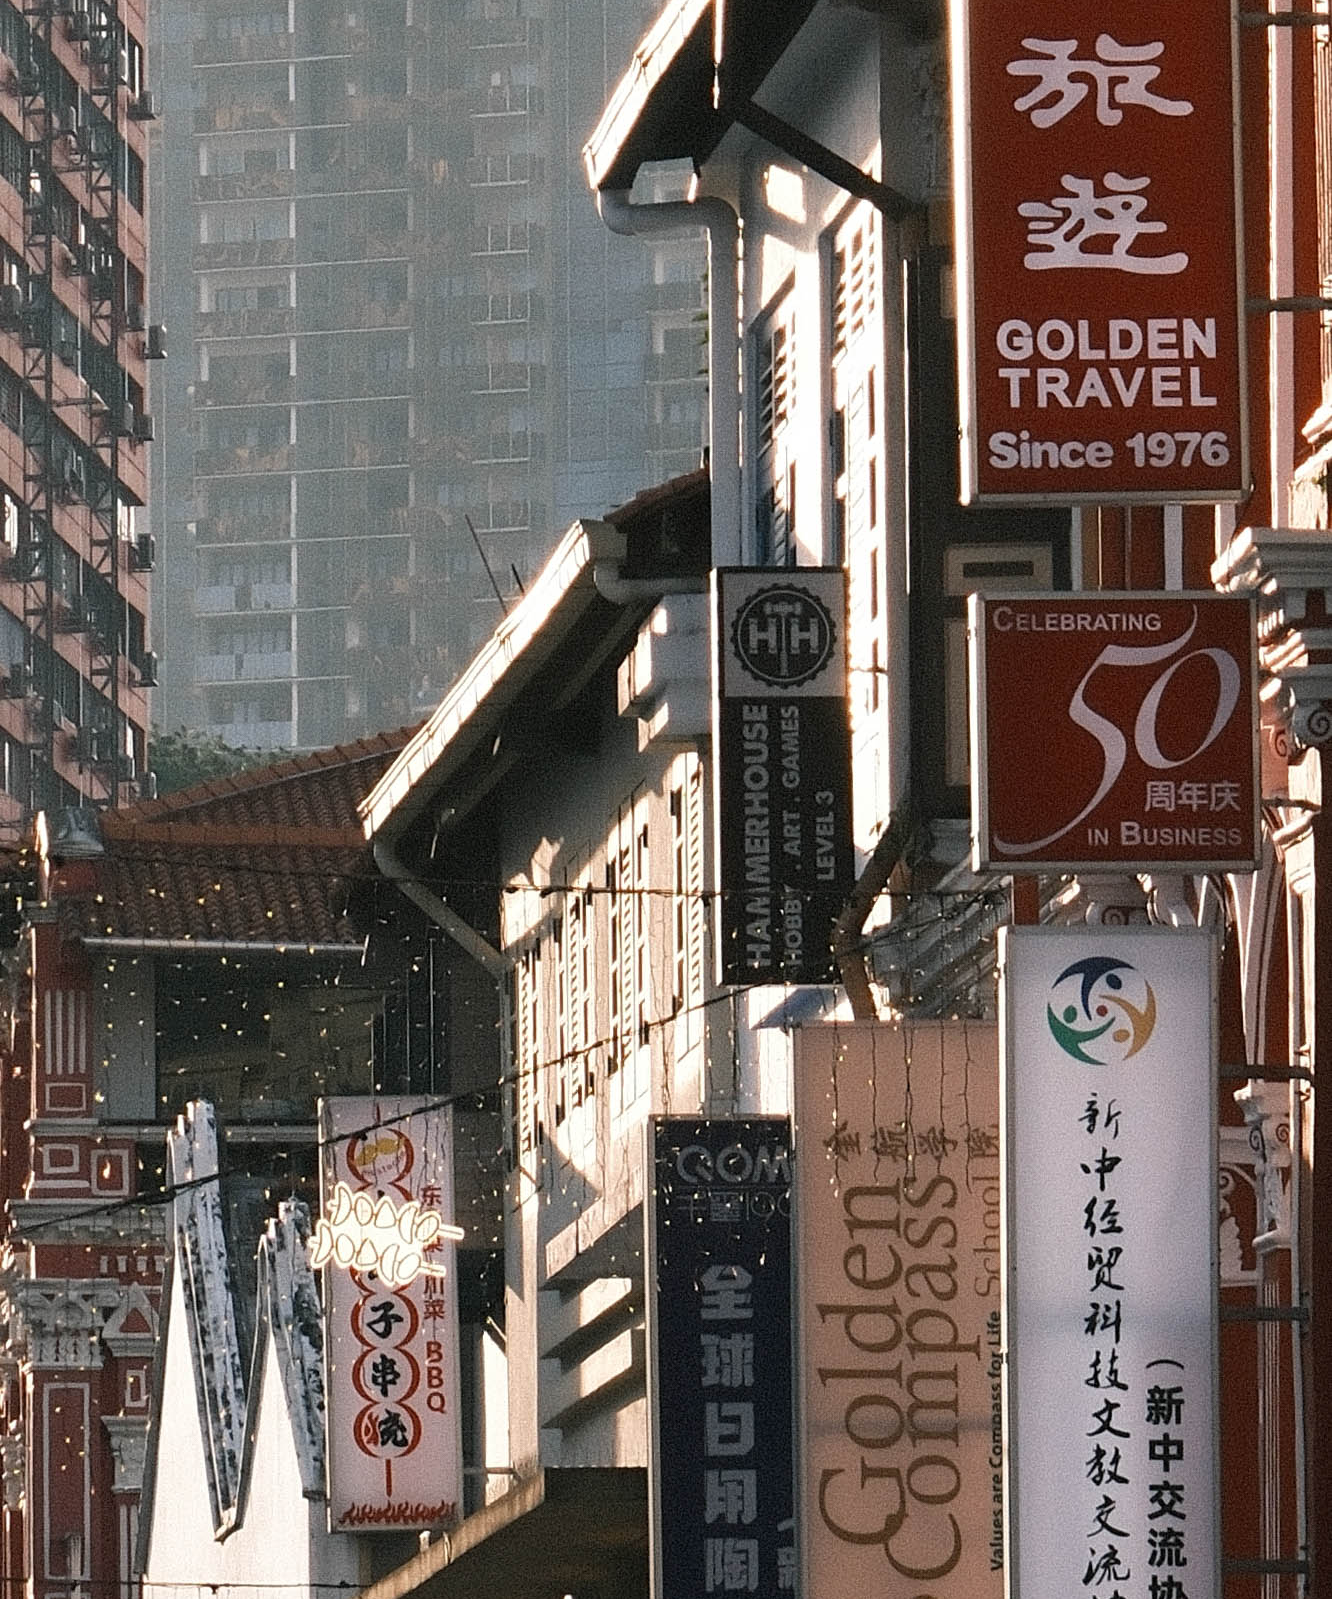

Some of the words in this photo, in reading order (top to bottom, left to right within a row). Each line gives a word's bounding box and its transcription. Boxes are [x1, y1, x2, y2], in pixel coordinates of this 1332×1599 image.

[995, 318, 1218, 362] GOLDEN
[997, 366, 1218, 408] TRAVEL
[988, 428, 1114, 468] Since
[1125, 428, 1230, 467] 1976
[992, 606, 1163, 633] CELEBRATING
[780, 706, 801, 789] GAMES
[993, 603, 1242, 855] 50
[815, 789, 835, 807] 3
[1144, 780, 1242, 812] 周年庆
[742, 703, 772, 968] HAMMERHOUSE
[782, 809, 801, 856] ART
[816, 811, 836, 881] LEVEL
[1120, 821, 1243, 847] BUSINESS
[363, 1188, 411, 1450] 子串烧
[425, 1338, 448, 1414] BBQ
[816, 1177, 904, 1544] Golden
[883, 1173, 981, 1581] Compass
